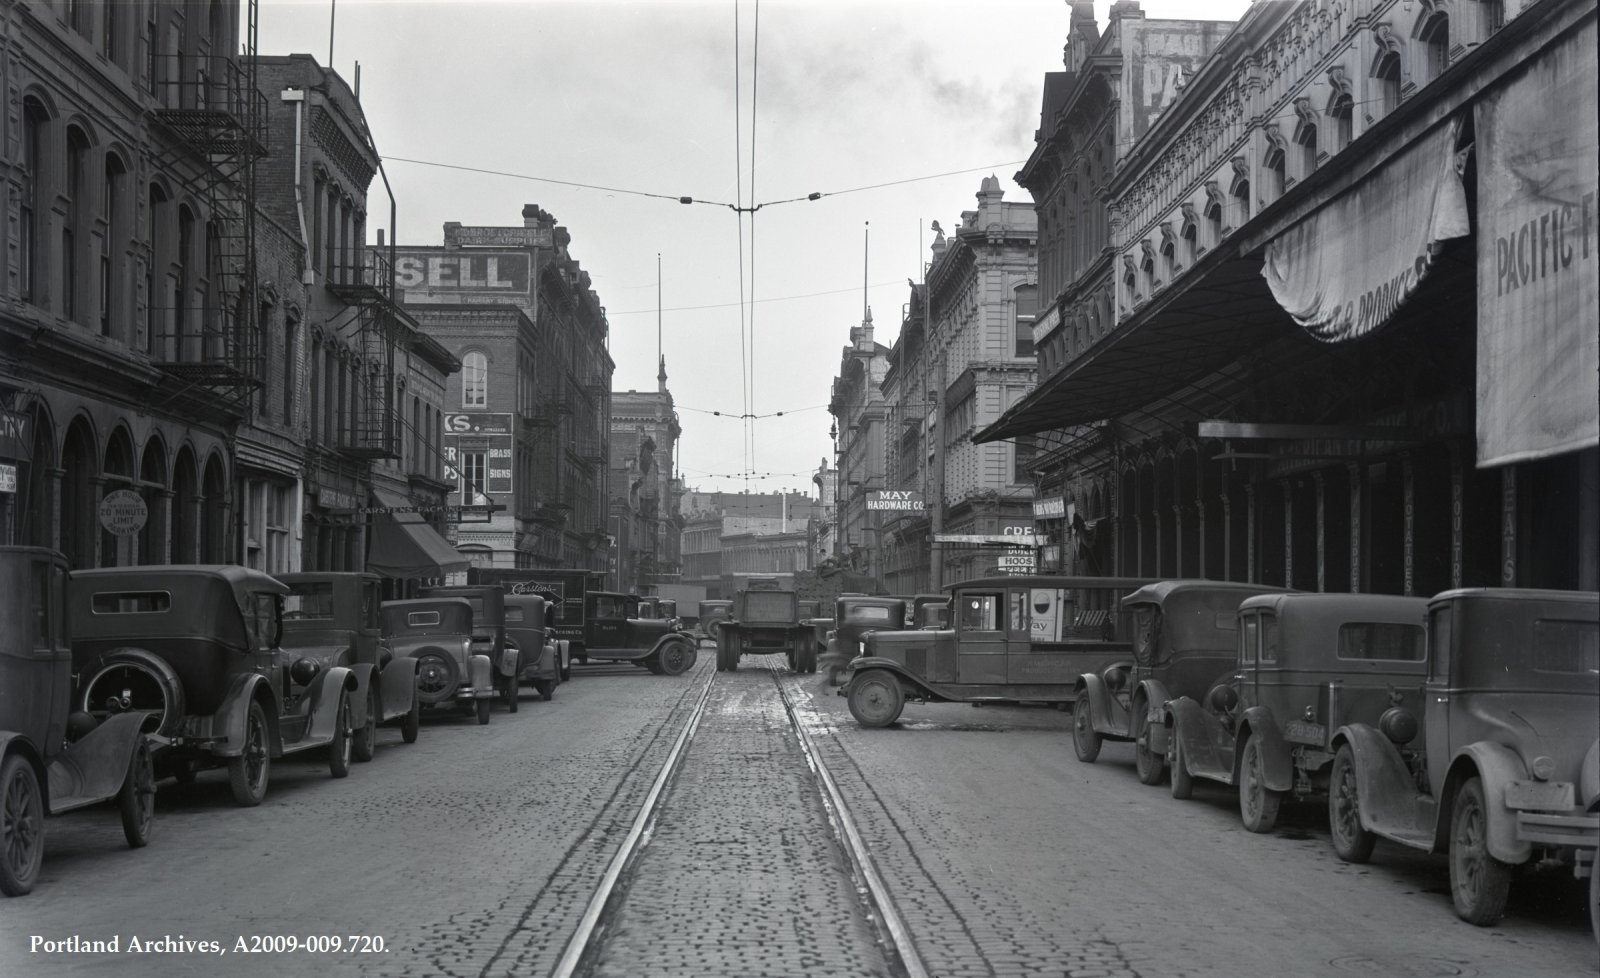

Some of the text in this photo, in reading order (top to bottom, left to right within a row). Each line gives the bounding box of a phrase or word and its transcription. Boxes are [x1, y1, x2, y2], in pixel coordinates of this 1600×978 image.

[1497, 204, 1573, 297] PACIFIC
[489, 448, 512, 458] BRASS
[489, 468, 512, 479] SIGNS
[880, 490, 912, 500] MAY
[867, 500, 912, 511] HARDWARE
[115, 508, 146, 517] MINUTE
[113, 516, 134, 525] LIMIT
[1503, 466, 1515, 582] MEATS
[1453, 484, 1461, 589] POULTRY
